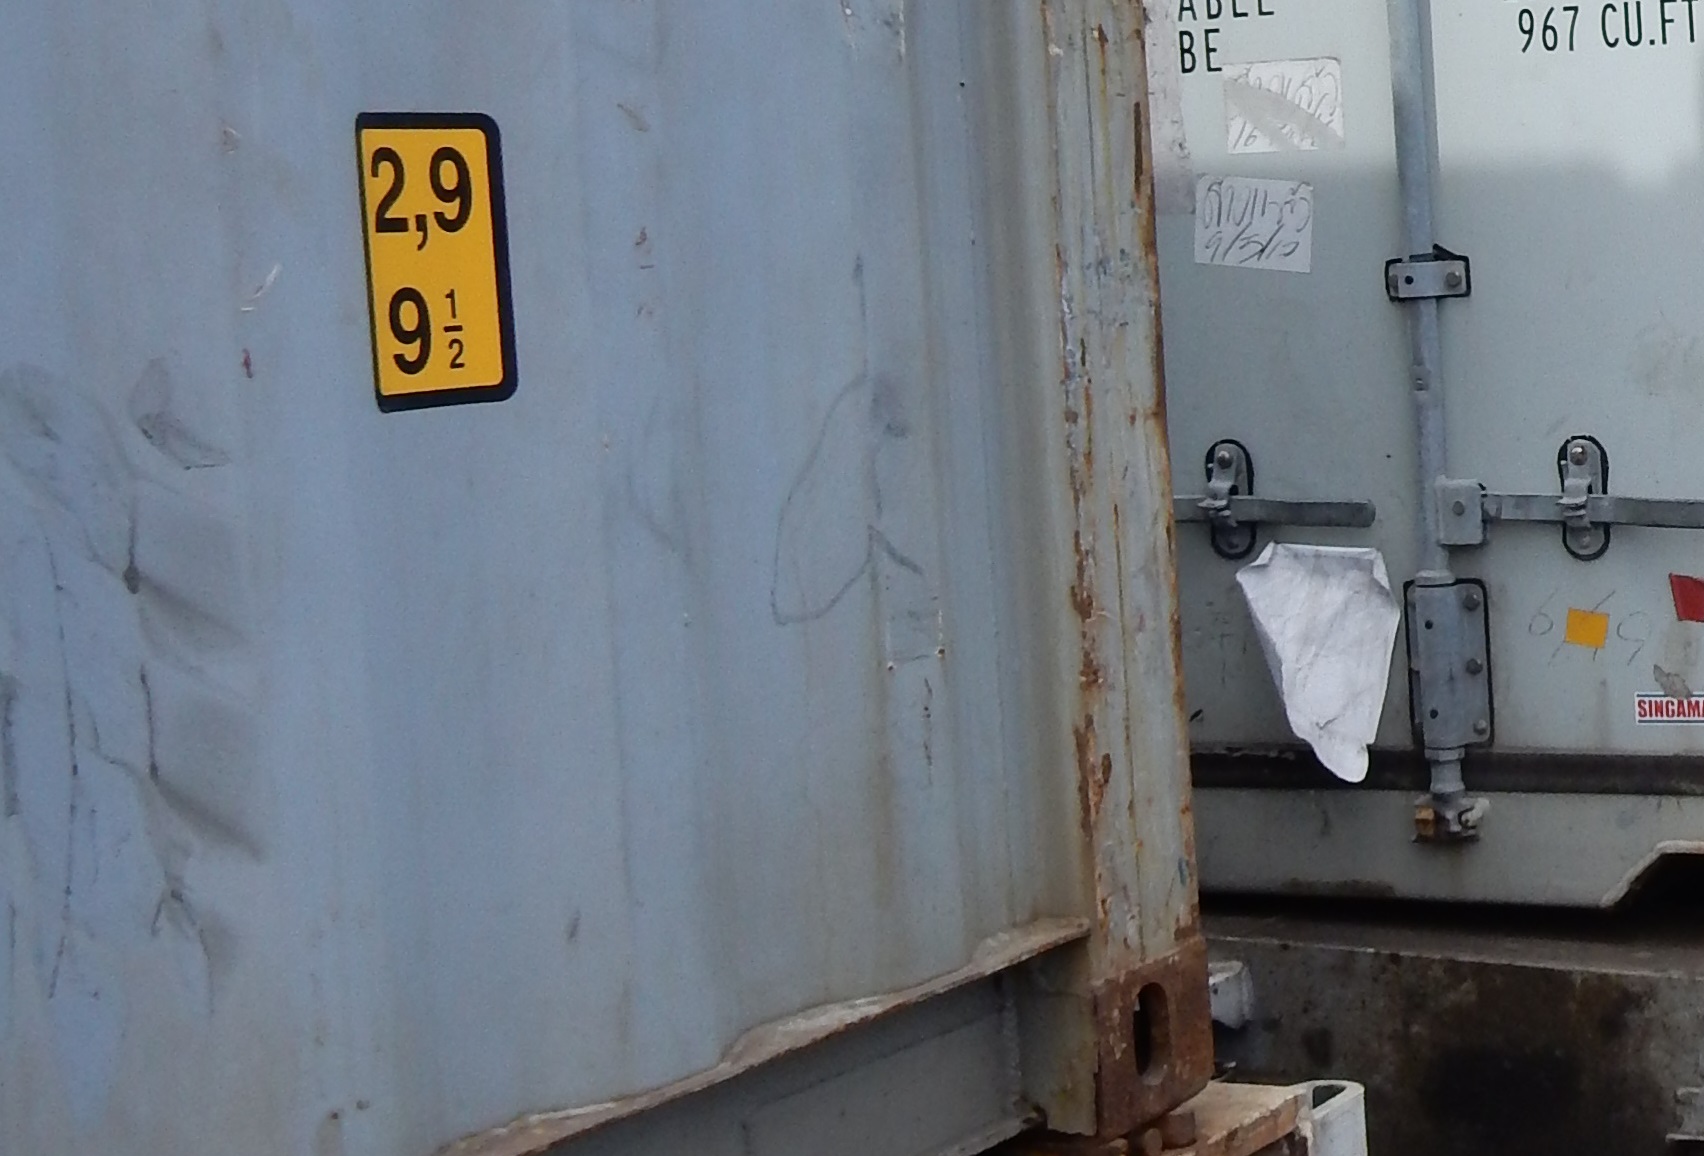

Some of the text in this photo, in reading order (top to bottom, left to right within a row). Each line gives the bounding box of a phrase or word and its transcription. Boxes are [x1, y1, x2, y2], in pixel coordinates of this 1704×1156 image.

[1179, 28, 1222, 73] BE
[1518, 0, 1699, 53] 967 CU.FT
[371, 146, 472, 251] 2,9
[389, 286, 432, 375] 9
